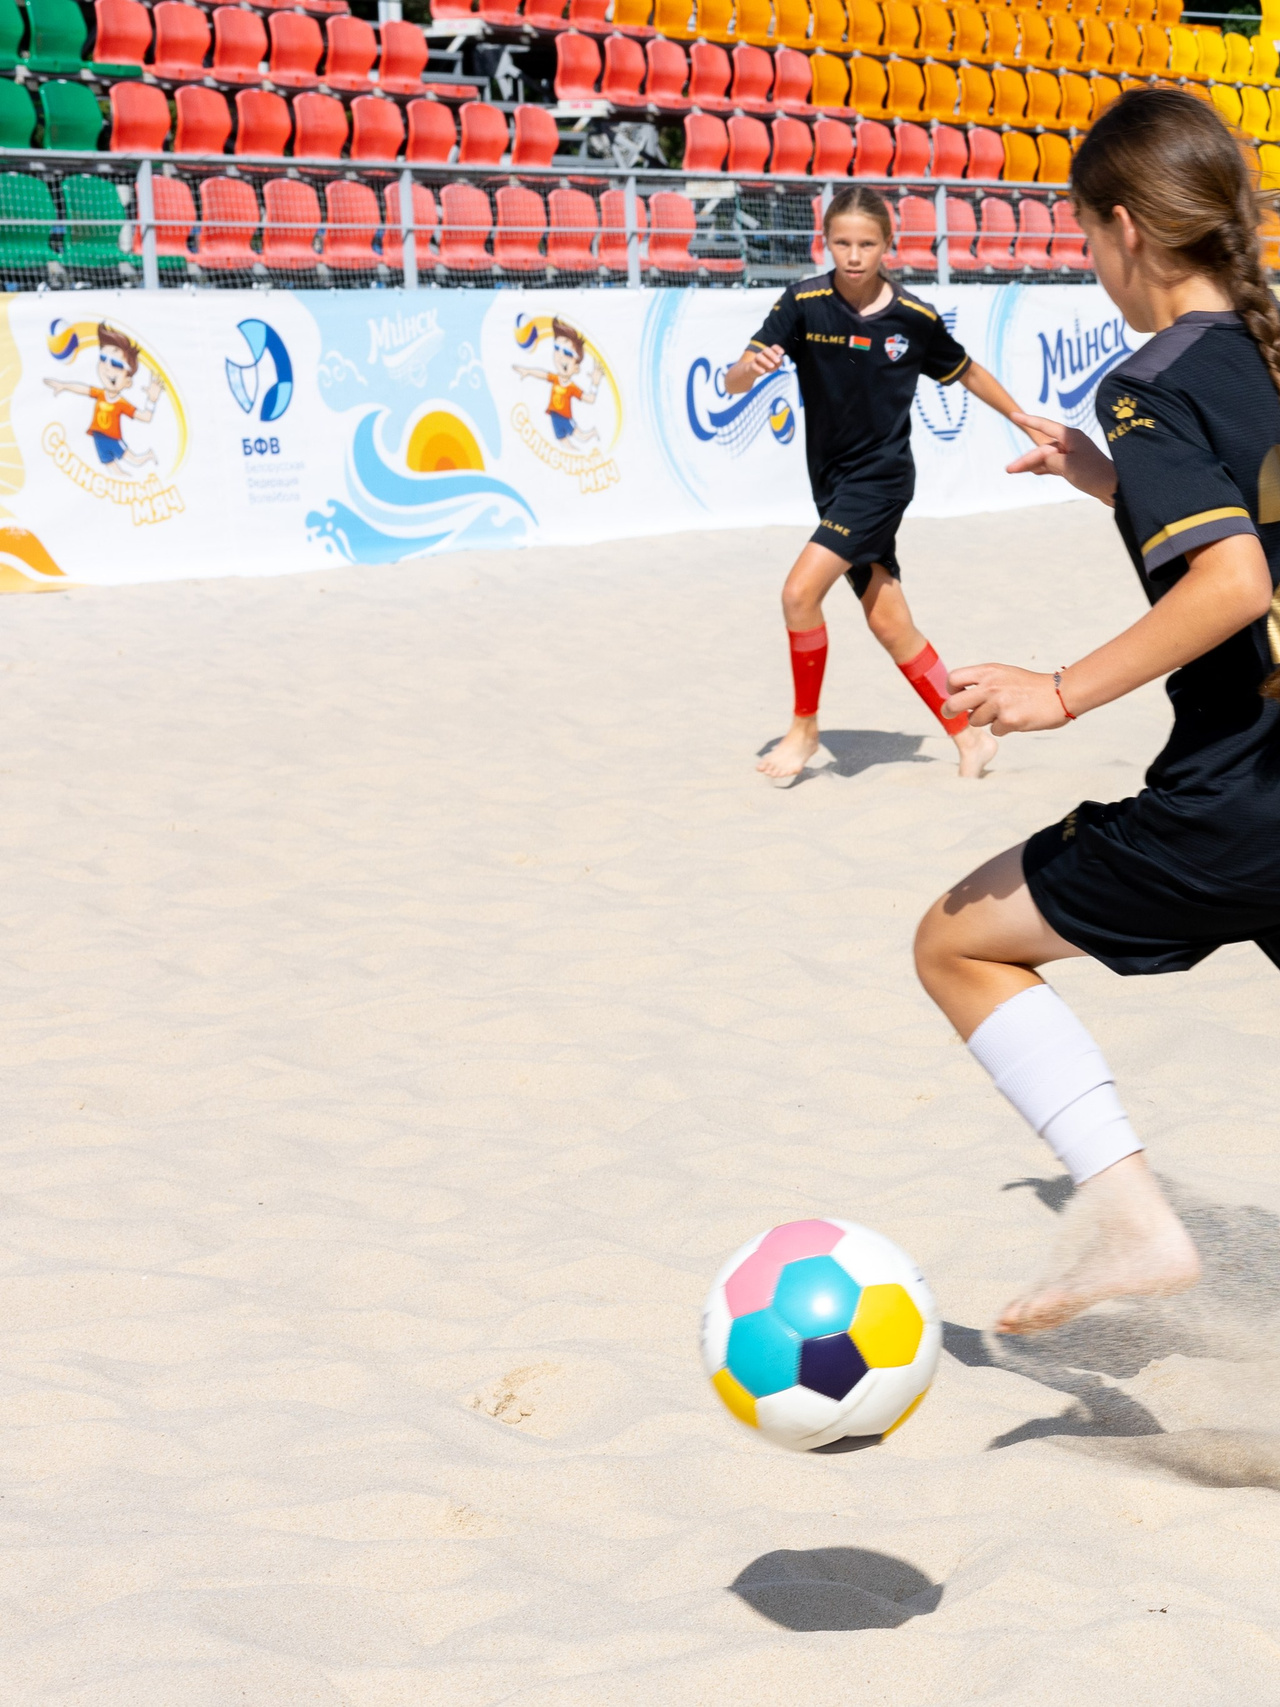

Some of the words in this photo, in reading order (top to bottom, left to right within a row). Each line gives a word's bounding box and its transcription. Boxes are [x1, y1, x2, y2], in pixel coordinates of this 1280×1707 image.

[806, 332, 847, 345] KELME
[1106, 417, 1156, 442] KELME
[242, 437, 281, 456] БФВ
[821, 518, 851, 537] ELME
